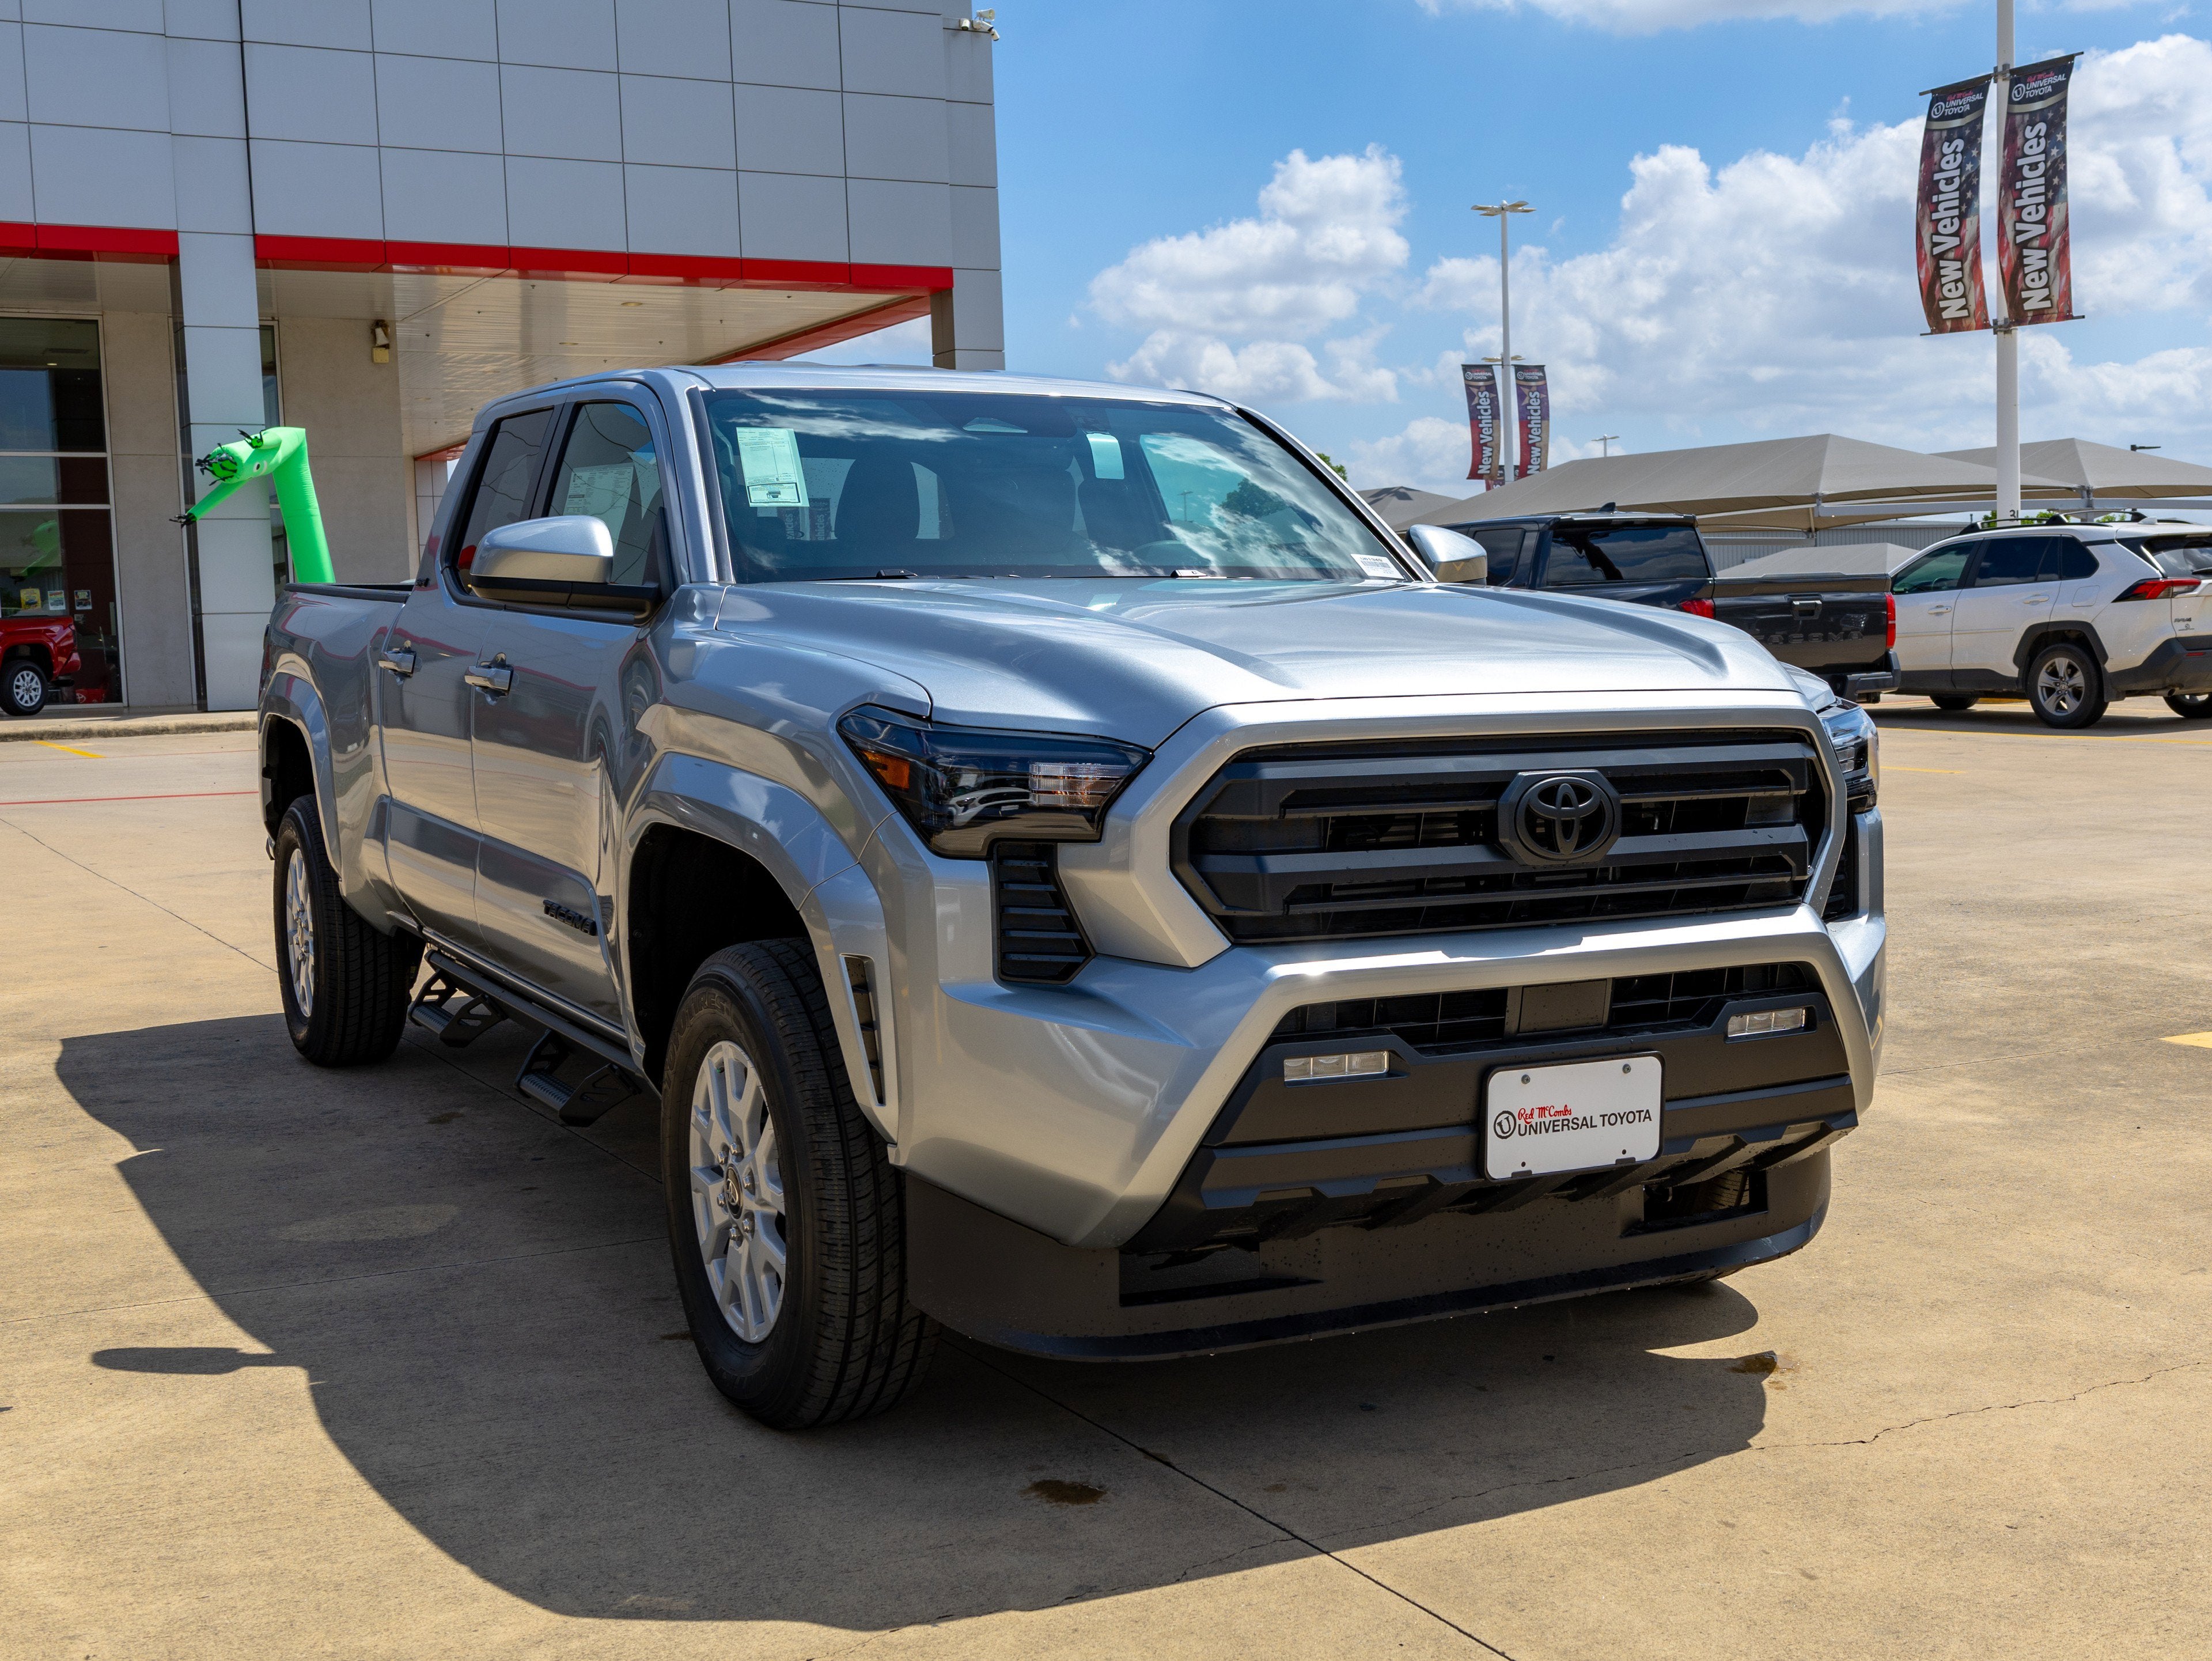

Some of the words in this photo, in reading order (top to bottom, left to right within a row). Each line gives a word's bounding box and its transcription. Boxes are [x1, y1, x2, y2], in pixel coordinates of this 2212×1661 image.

[2025, 85, 2052, 98] TOYOTA
[2026, 74, 2066, 90] UNIVERSAL
[1944, 104, 1970, 116] TOYOTA
[1946, 92, 1984, 108] UNIVERSAL
[1931, 138, 1965, 255] Vehicles
[2016, 122, 2047, 244] Vehicles
[1939, 260, 1969, 319] New
[2022, 249, 2052, 311] New
[1476, 391, 1493, 444] Vehicles
[1527, 391, 1541, 444] Vehicles
[1478, 447, 1493, 474] New
[1527, 447, 1541, 474] New
[1518, 1107, 1535, 1124] Red
[1536, 1104, 1572, 1119] McCombs
[1518, 1115, 1597, 1137] UNIVERSAL
[1600, 1109, 1652, 1127] TOYOTA
